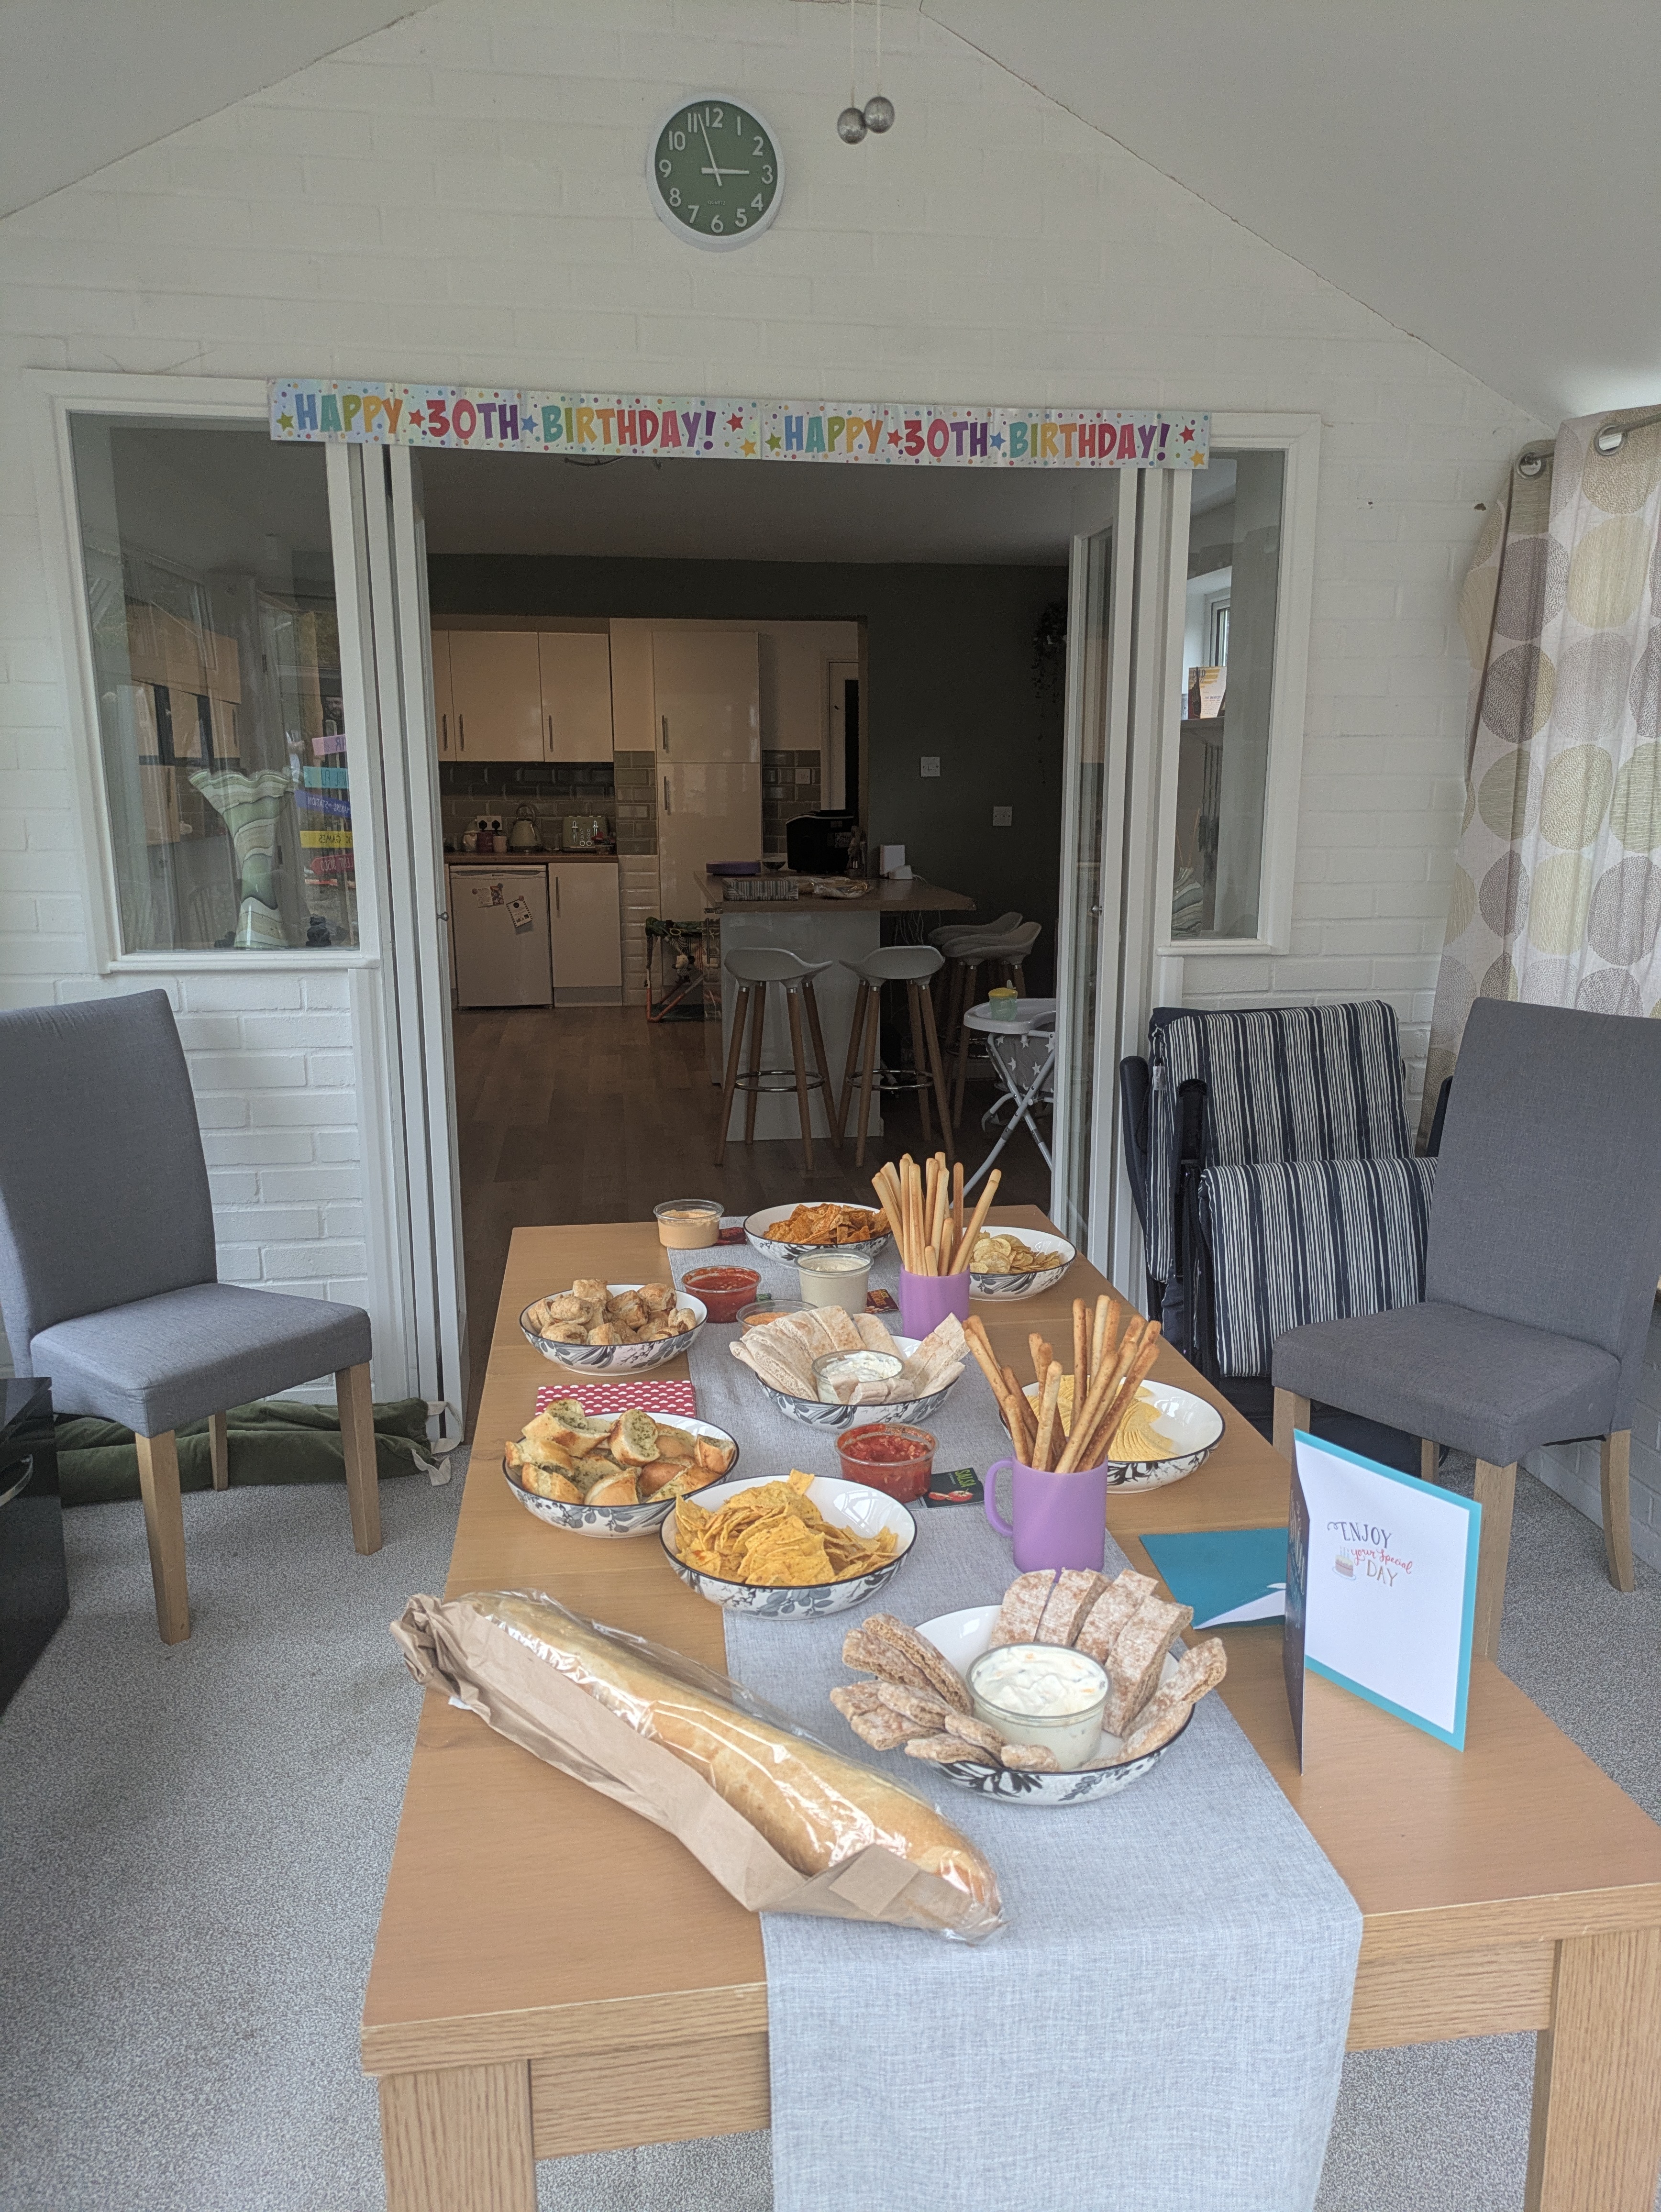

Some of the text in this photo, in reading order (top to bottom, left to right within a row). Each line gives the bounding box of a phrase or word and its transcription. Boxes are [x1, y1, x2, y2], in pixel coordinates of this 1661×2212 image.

[687, 113, 698, 133] 11
[706, 107, 723, 128] 12
[737, 116, 741, 136] 1
[669, 131, 686, 151] 10
[752, 136, 764, 156] 2
[659, 159, 672, 178] 9
[761, 165, 773, 184] 3
[670, 188, 681, 207] 8
[751, 192, 764, 211] 4
[687, 204, 699, 223] 7
[734, 208, 747, 227] 5
[711, 215, 724, 233] 6
[295, 393, 1171, 461] HAPPY 30TH BIRTHDAY! HAPPY 30TH BIRTHDAY!
[955, 1470, 976, 1488] SALSA
[1327, 1522, 1392, 1548] ENJOY
[1351, 1548, 1376, 1566] your
[1367, 1559, 1398, 1587] DAY
